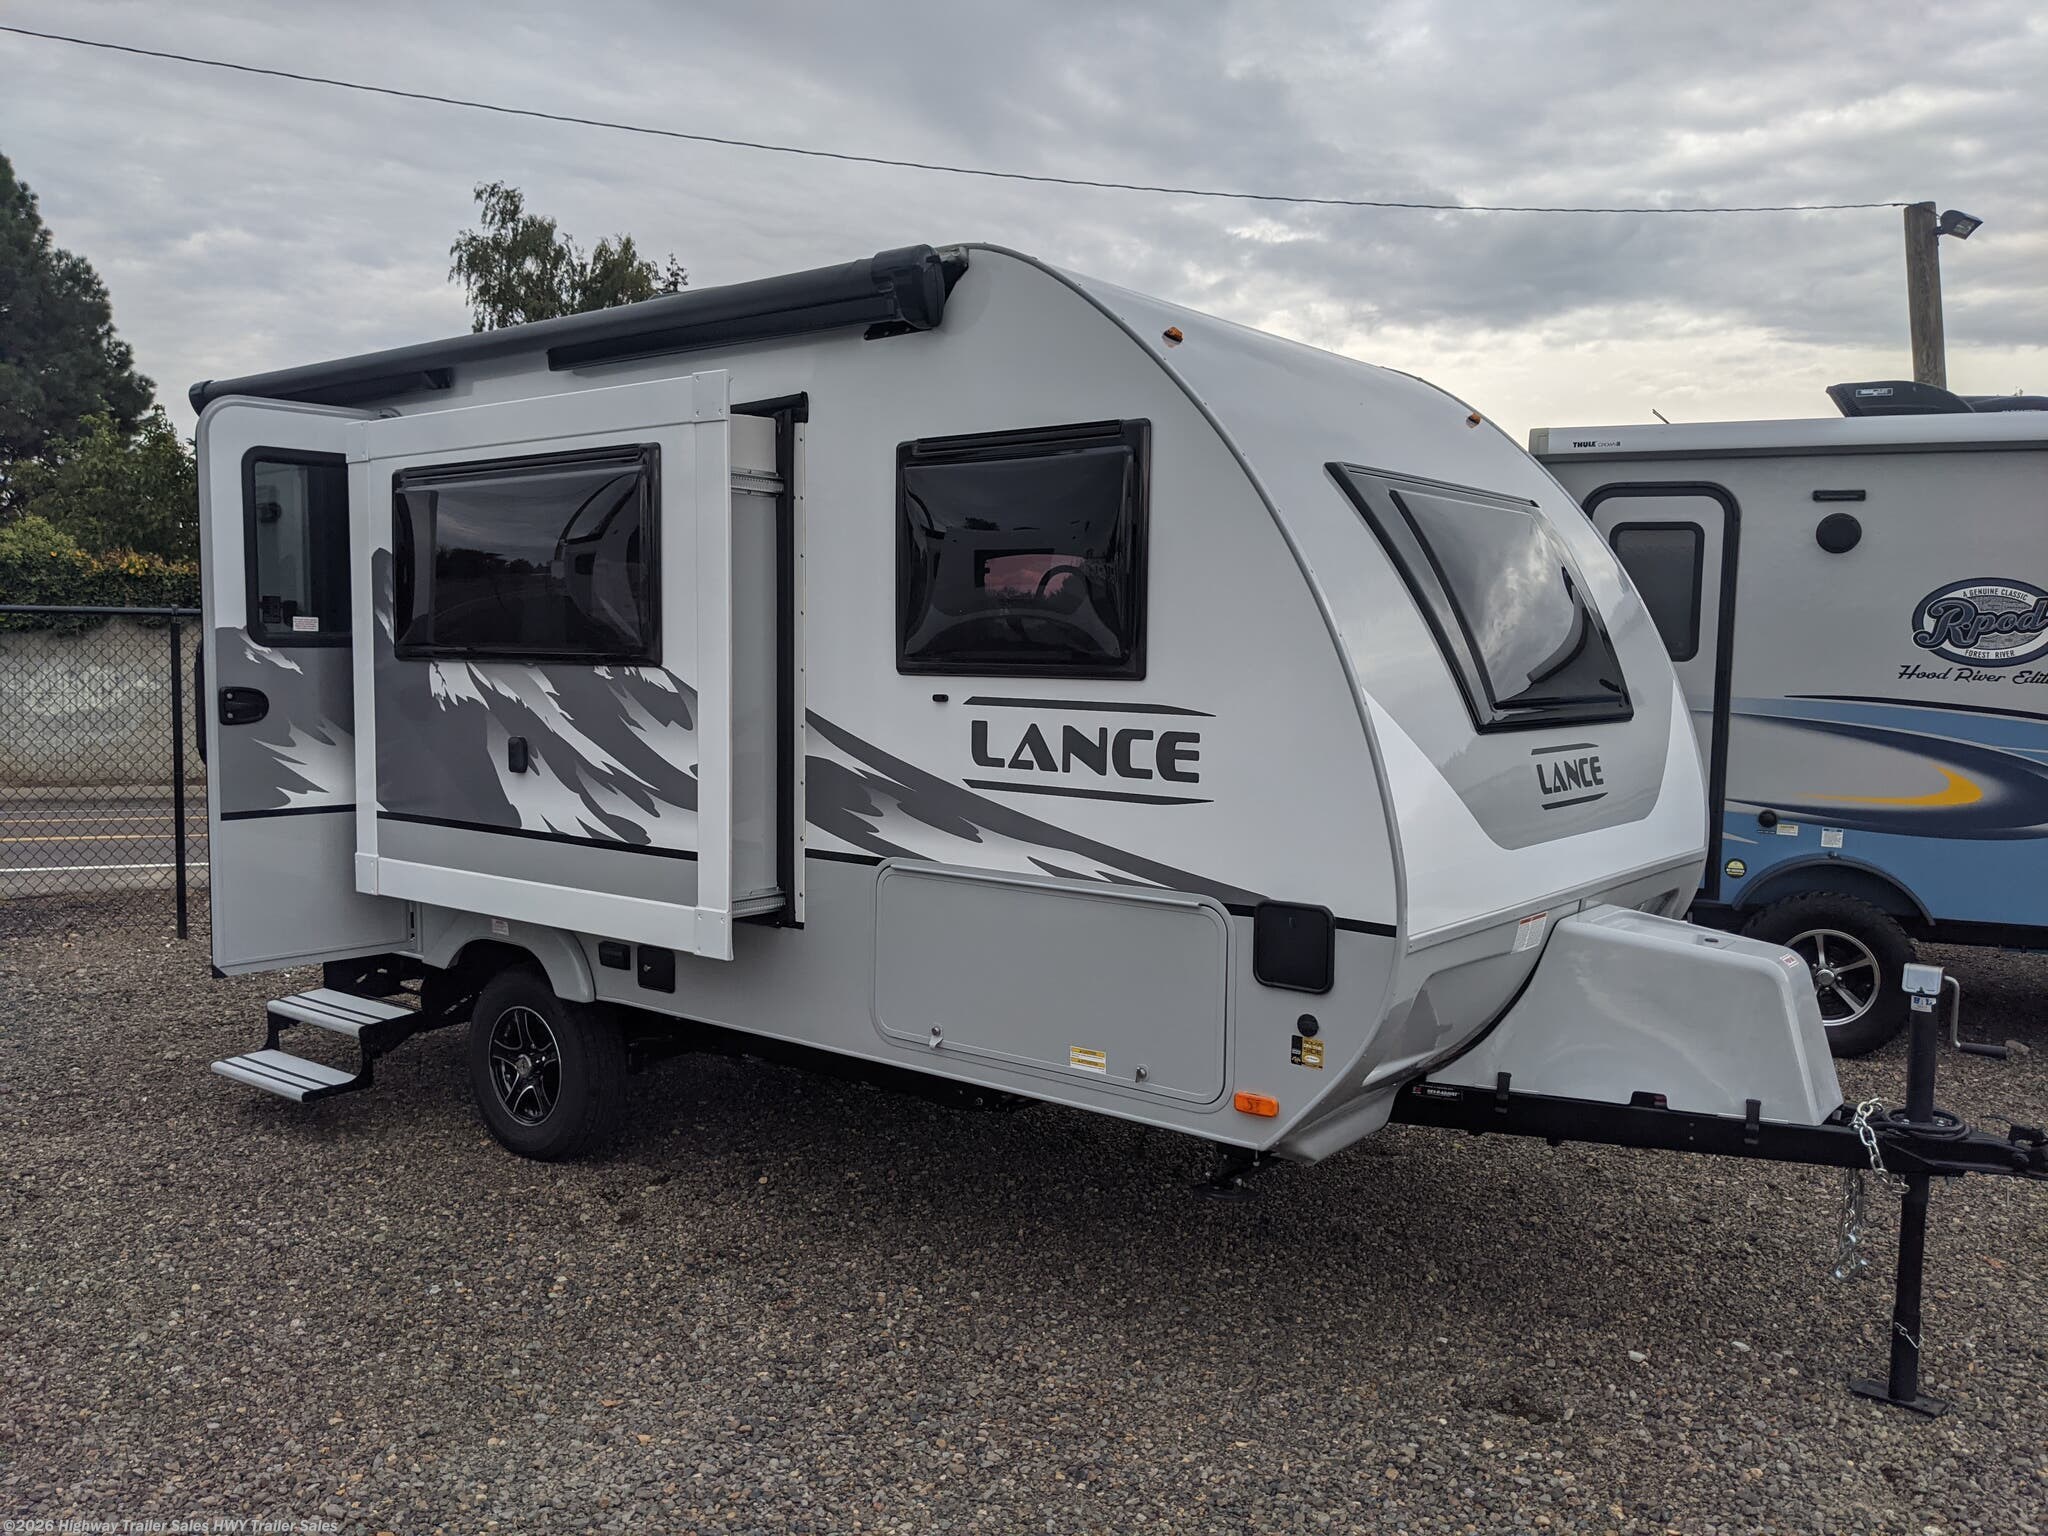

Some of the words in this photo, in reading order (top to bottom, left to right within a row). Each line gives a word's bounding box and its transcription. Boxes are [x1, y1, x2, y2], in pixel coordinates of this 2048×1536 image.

[1968, 588, 1999, 597] GENUINE
[2000, 587, 2029, 601] CLASSIC
[1965, 650, 1990, 658] FOREST
[1994, 649, 2015, 658] RIVER
[1897, 664, 1953, 680] Hood
[1954, 667, 2007, 683] River
[2012, 670, 2048, 685] Edit
[971, 719, 1200, 784] LANCE
[1536, 756, 1604, 795] LANCE
